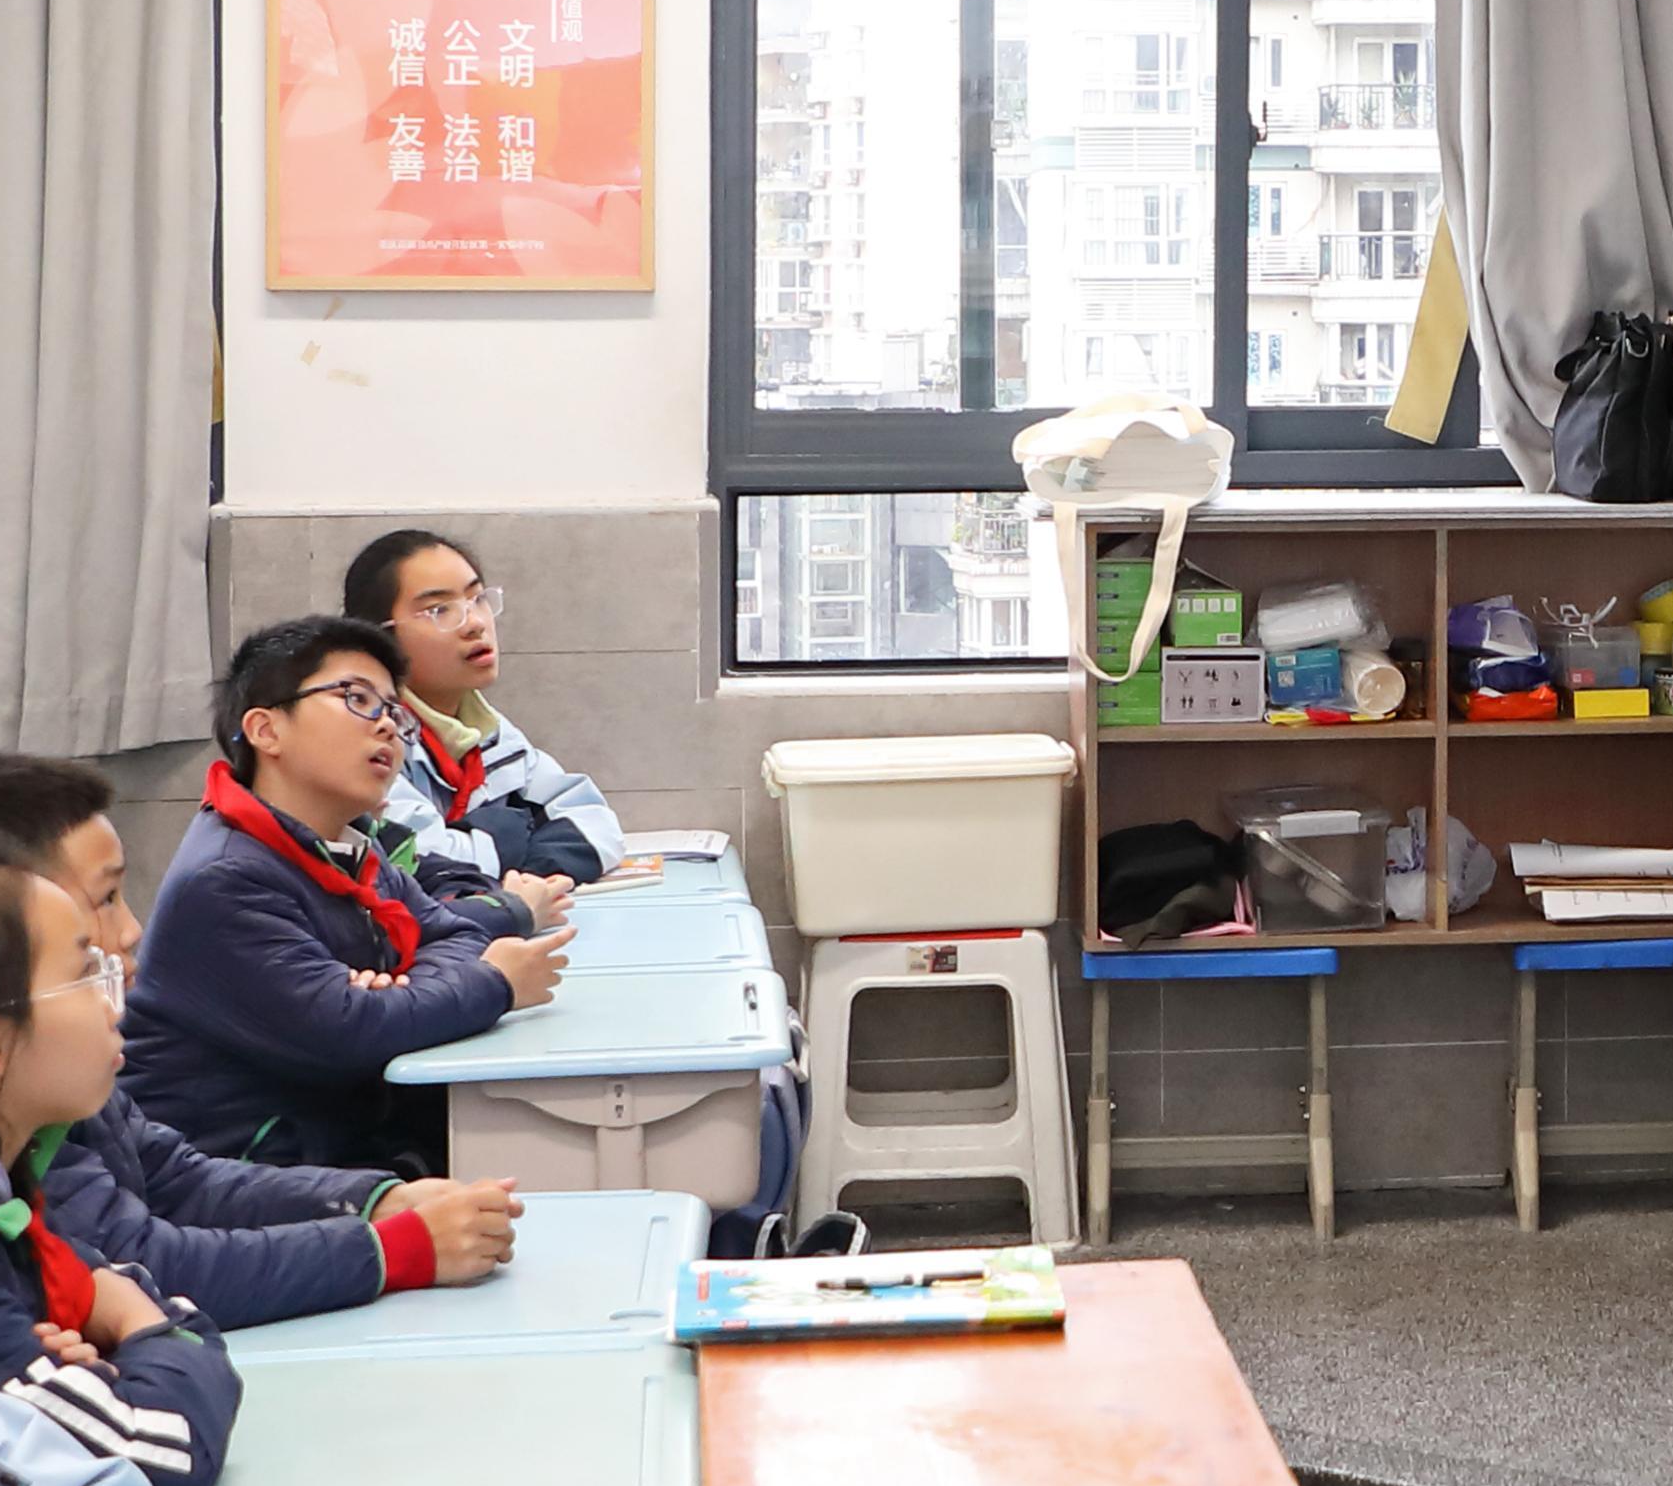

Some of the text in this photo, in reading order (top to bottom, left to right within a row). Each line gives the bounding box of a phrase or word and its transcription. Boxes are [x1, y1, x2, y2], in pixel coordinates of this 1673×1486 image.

[388, 18, 426, 87] 诚信
[443, 19, 481, 87] 公正
[498, 18, 536, 88] 文明
[388, 113, 426, 182] 友善
[443, 114, 481, 182] 法治
[498, 114, 536, 183] 和谐
